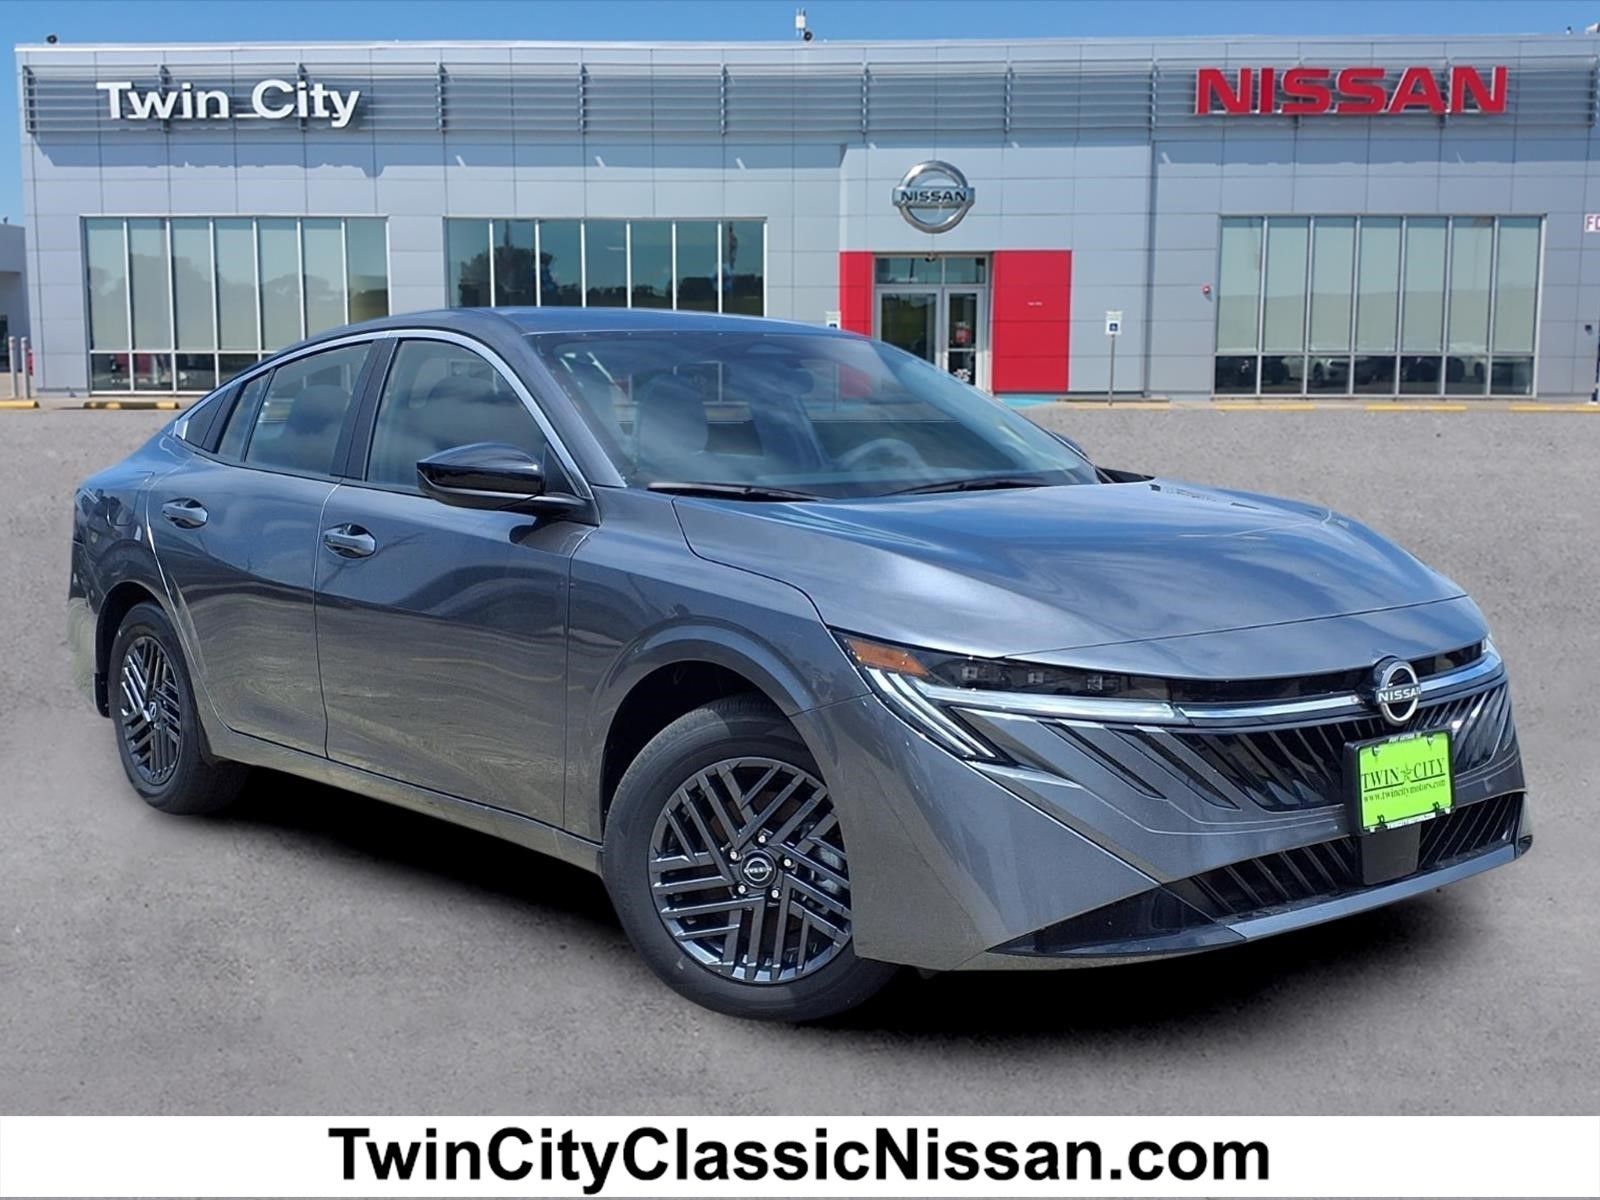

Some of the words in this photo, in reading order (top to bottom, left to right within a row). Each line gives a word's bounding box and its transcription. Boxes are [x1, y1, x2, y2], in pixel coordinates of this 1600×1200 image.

[96, 81, 230, 119] Twin
[252, 79, 361, 128] City
[1194, 66, 1508, 115] NISSAN
[900, 190, 967, 202] NISSAN
[1378, 687, 1421, 702] NISSAN
[1362, 767, 1400, 789] TWIN
[1413, 758, 1445, 779] CITY
